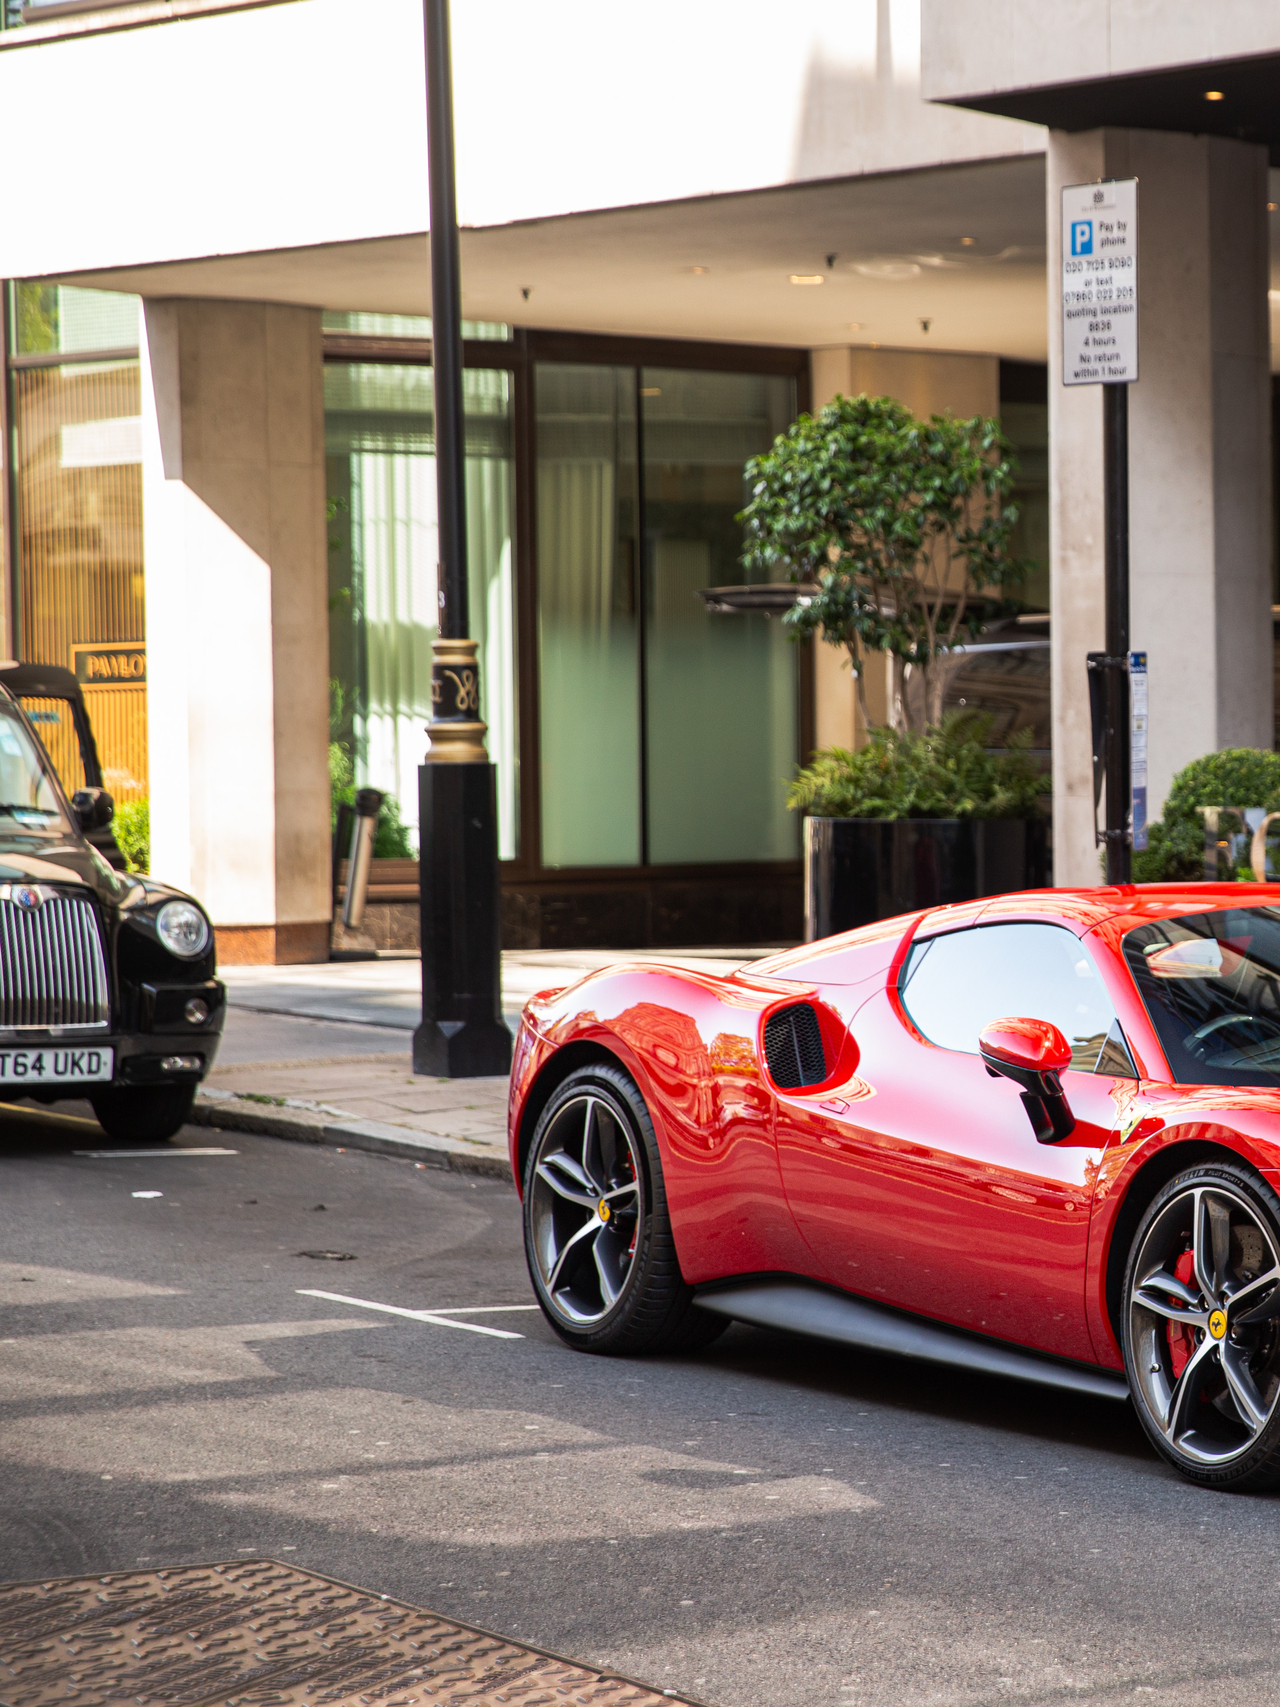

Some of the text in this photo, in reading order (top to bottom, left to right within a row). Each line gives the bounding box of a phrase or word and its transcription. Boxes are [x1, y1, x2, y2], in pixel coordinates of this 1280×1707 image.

[1099, 219, 1127, 233] Pay by
[1075, 223, 1090, 254] P
[1100, 236, 1126, 249] phone
[1065, 261, 1083, 274] 020
[1084, 274, 1113, 288] or text
[1066, 302, 1135, 319] quoting location
[1083, 335, 1116, 347] 4 hours
[1079, 351, 1121, 364] No return
[1073, 367, 1100, 379] within
[1108, 365, 1127, 377] hour
[0, 1051, 102, 1078] T64 UKD
